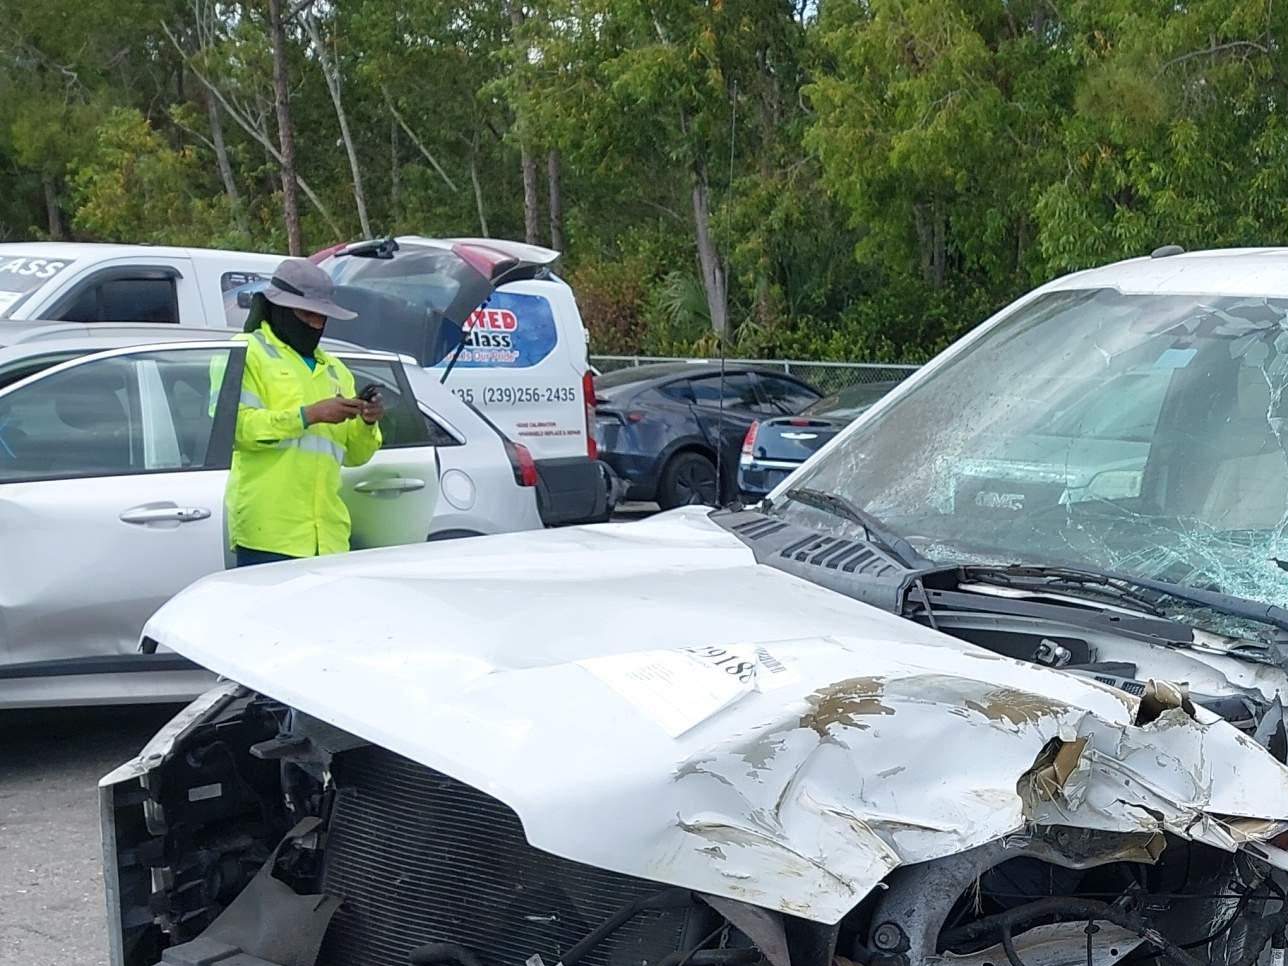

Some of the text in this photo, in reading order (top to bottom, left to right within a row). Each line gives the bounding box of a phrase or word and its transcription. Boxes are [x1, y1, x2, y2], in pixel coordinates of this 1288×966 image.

[0, 256, 65, 278] ASS
[451, 386, 576, 406] 35 (239)256-2435
